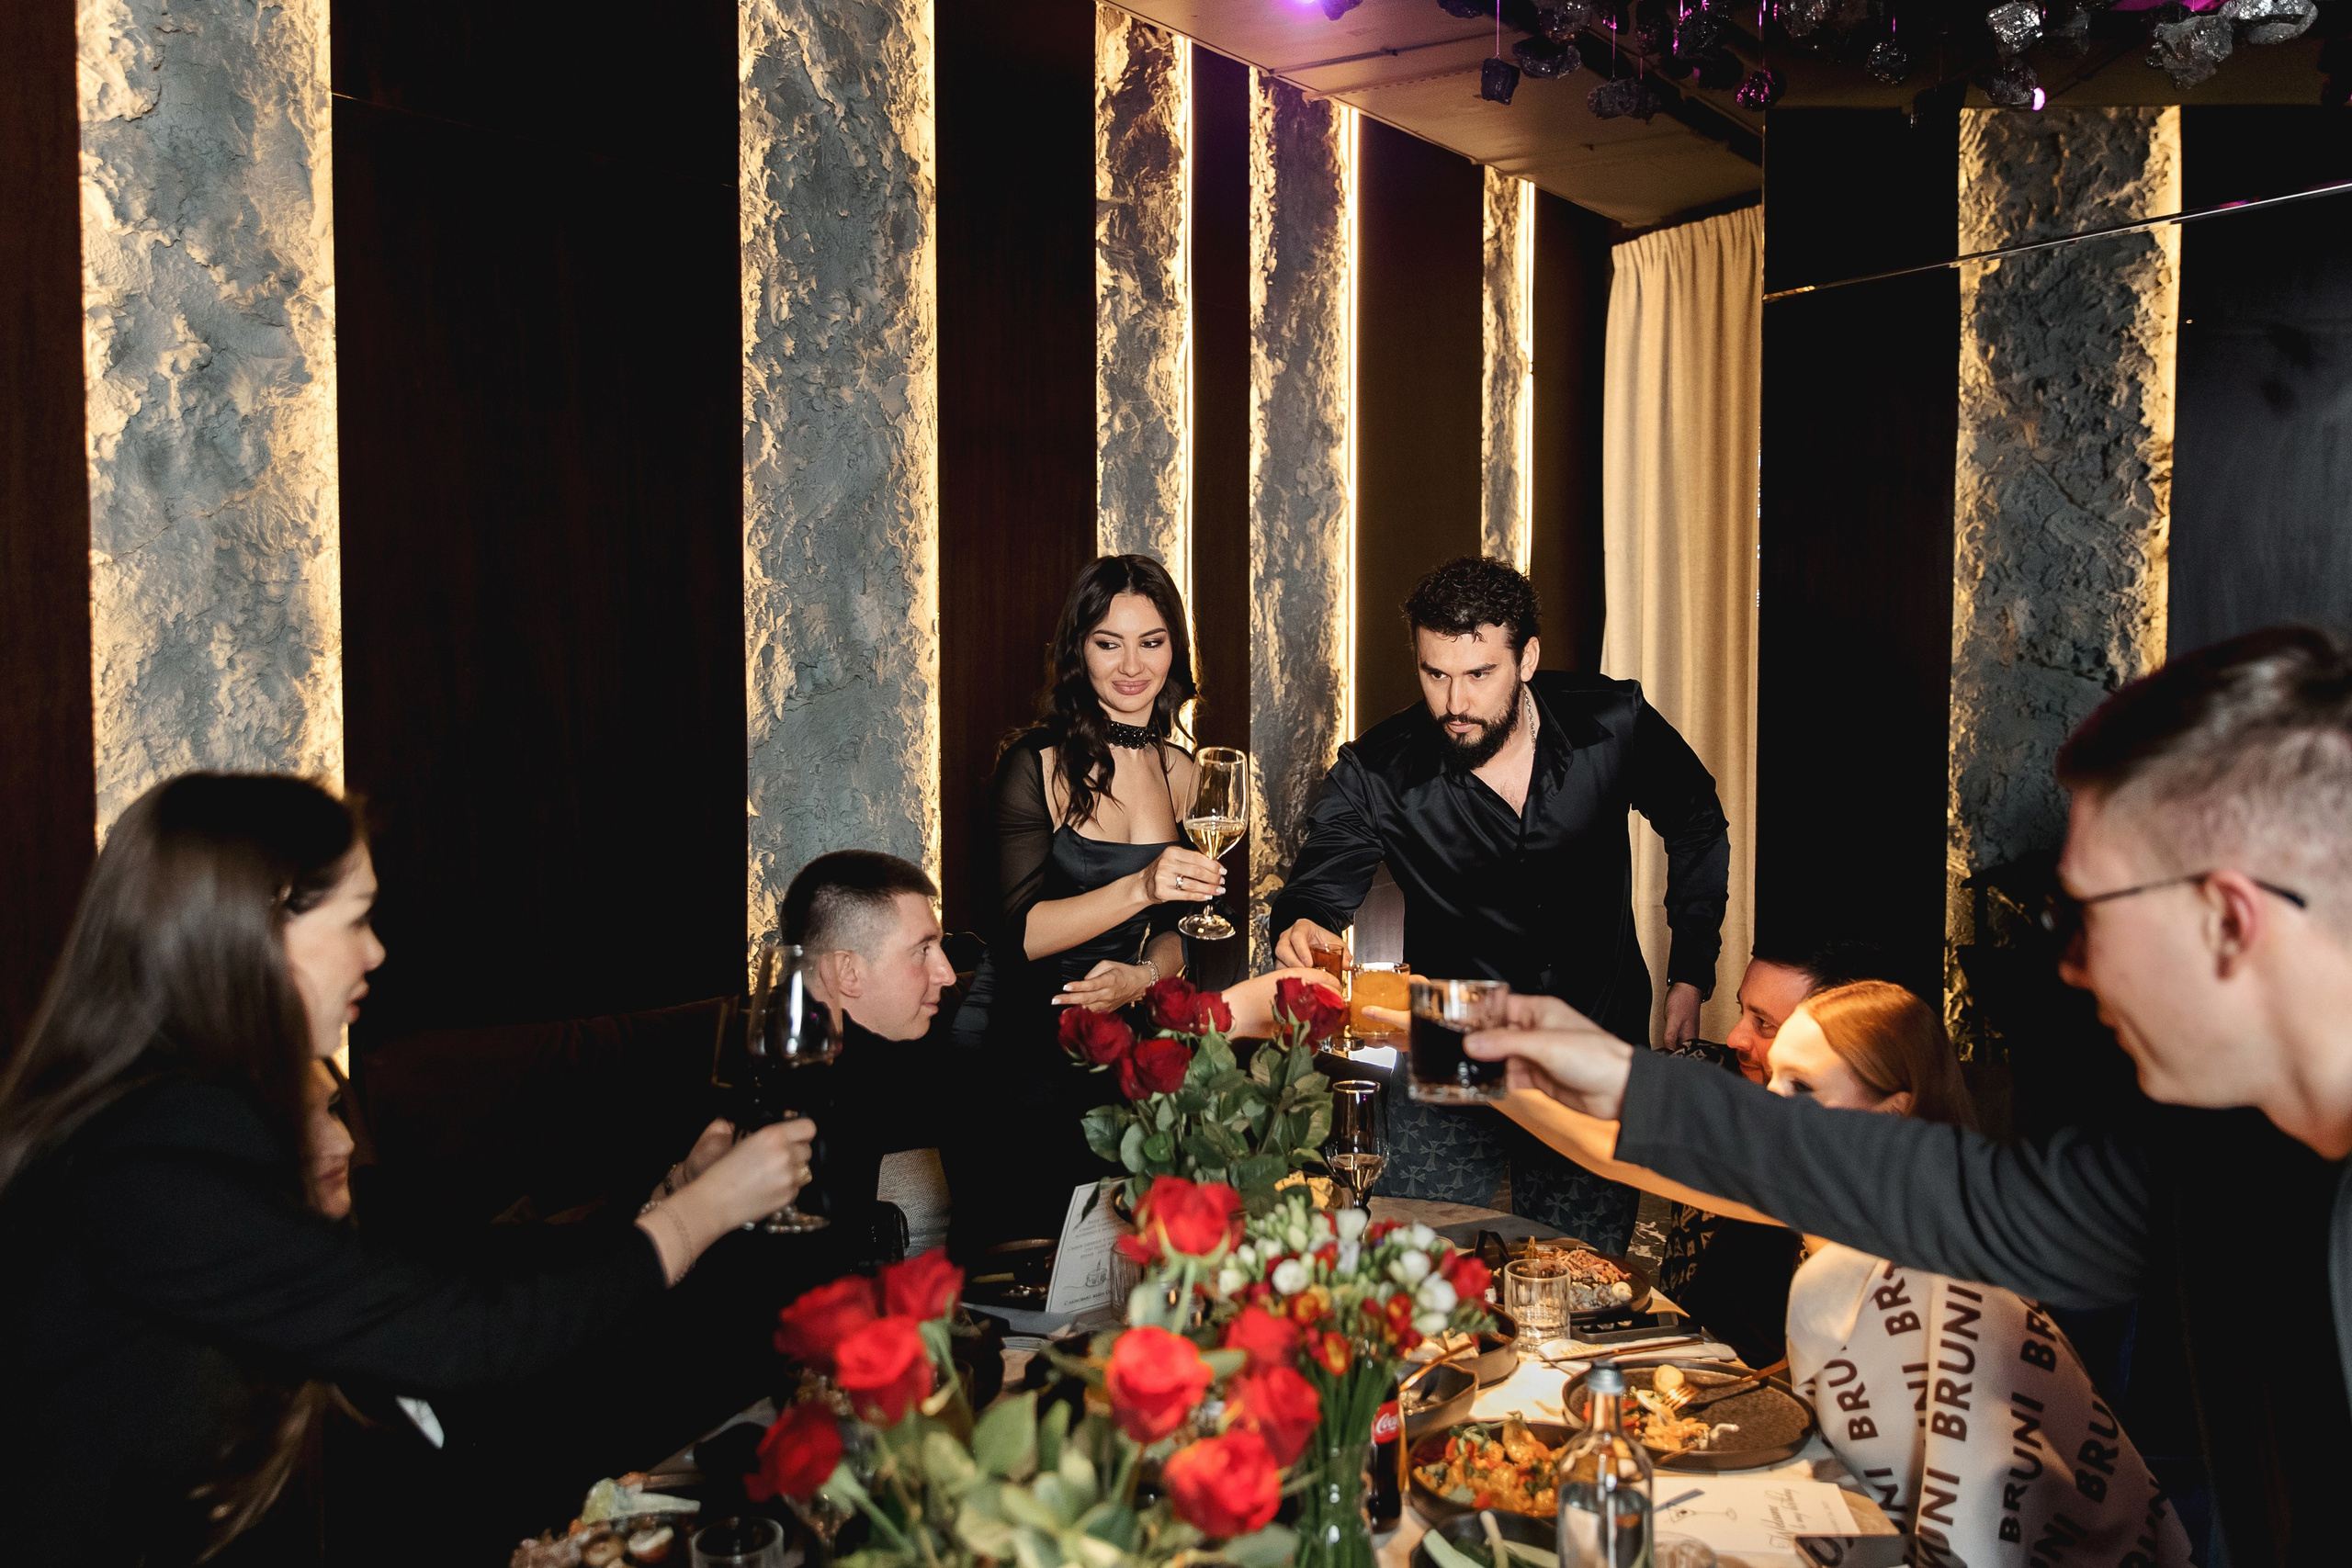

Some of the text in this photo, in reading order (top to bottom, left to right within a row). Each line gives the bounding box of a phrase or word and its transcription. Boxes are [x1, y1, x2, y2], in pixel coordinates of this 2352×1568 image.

[1824, 1345, 1879, 1441] BRU
[1930, 1282, 1983, 1442] BRUNI
[2020, 1303, 2057, 1372] BR
[1998, 1391, 2045, 1545] BRUNI
[2075, 1385, 2120, 1504] BRU
